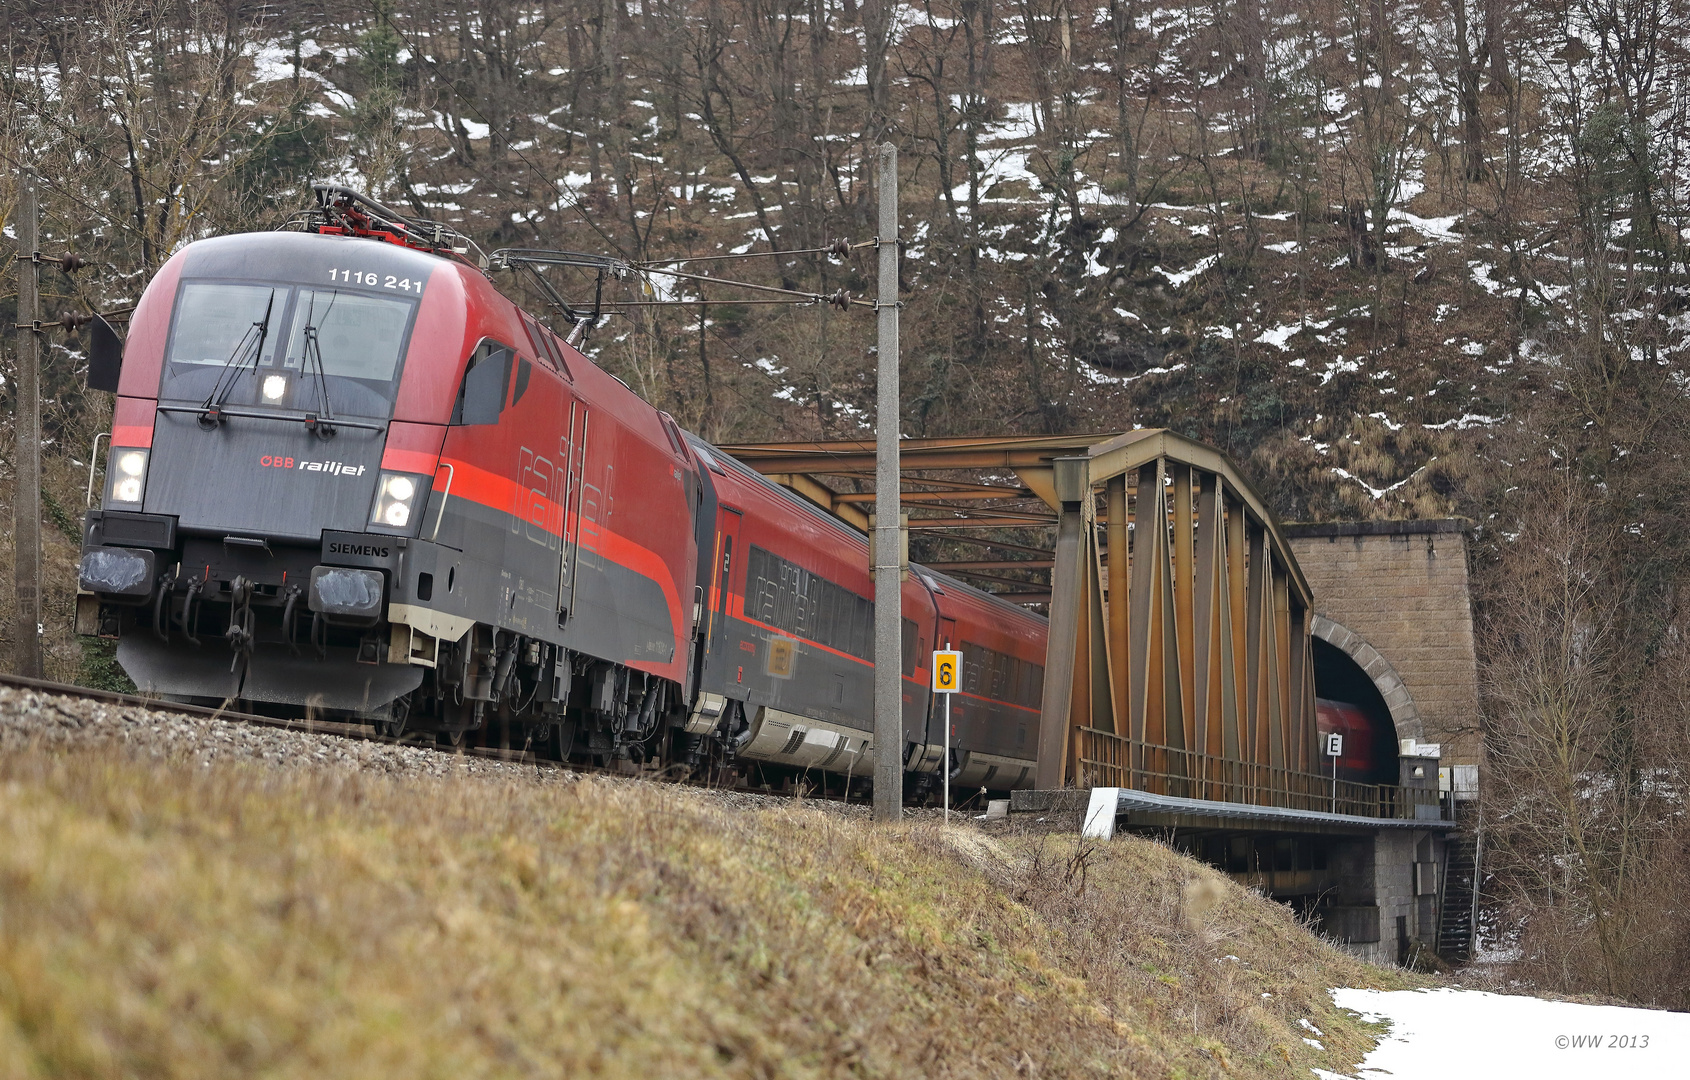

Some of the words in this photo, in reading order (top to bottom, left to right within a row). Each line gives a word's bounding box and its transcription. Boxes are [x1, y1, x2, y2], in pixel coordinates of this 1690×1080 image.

[328, 268, 378, 286] 1116
[383, 275, 422, 294] 241
[260, 455, 294, 469] ÖBB
[299, 460, 366, 476] railjet
[329, 542, 389, 558] SIEMENS
[723, 552, 730, 573] 2
[939, 662, 952, 686] 6
[1330, 737, 1339, 753] E
